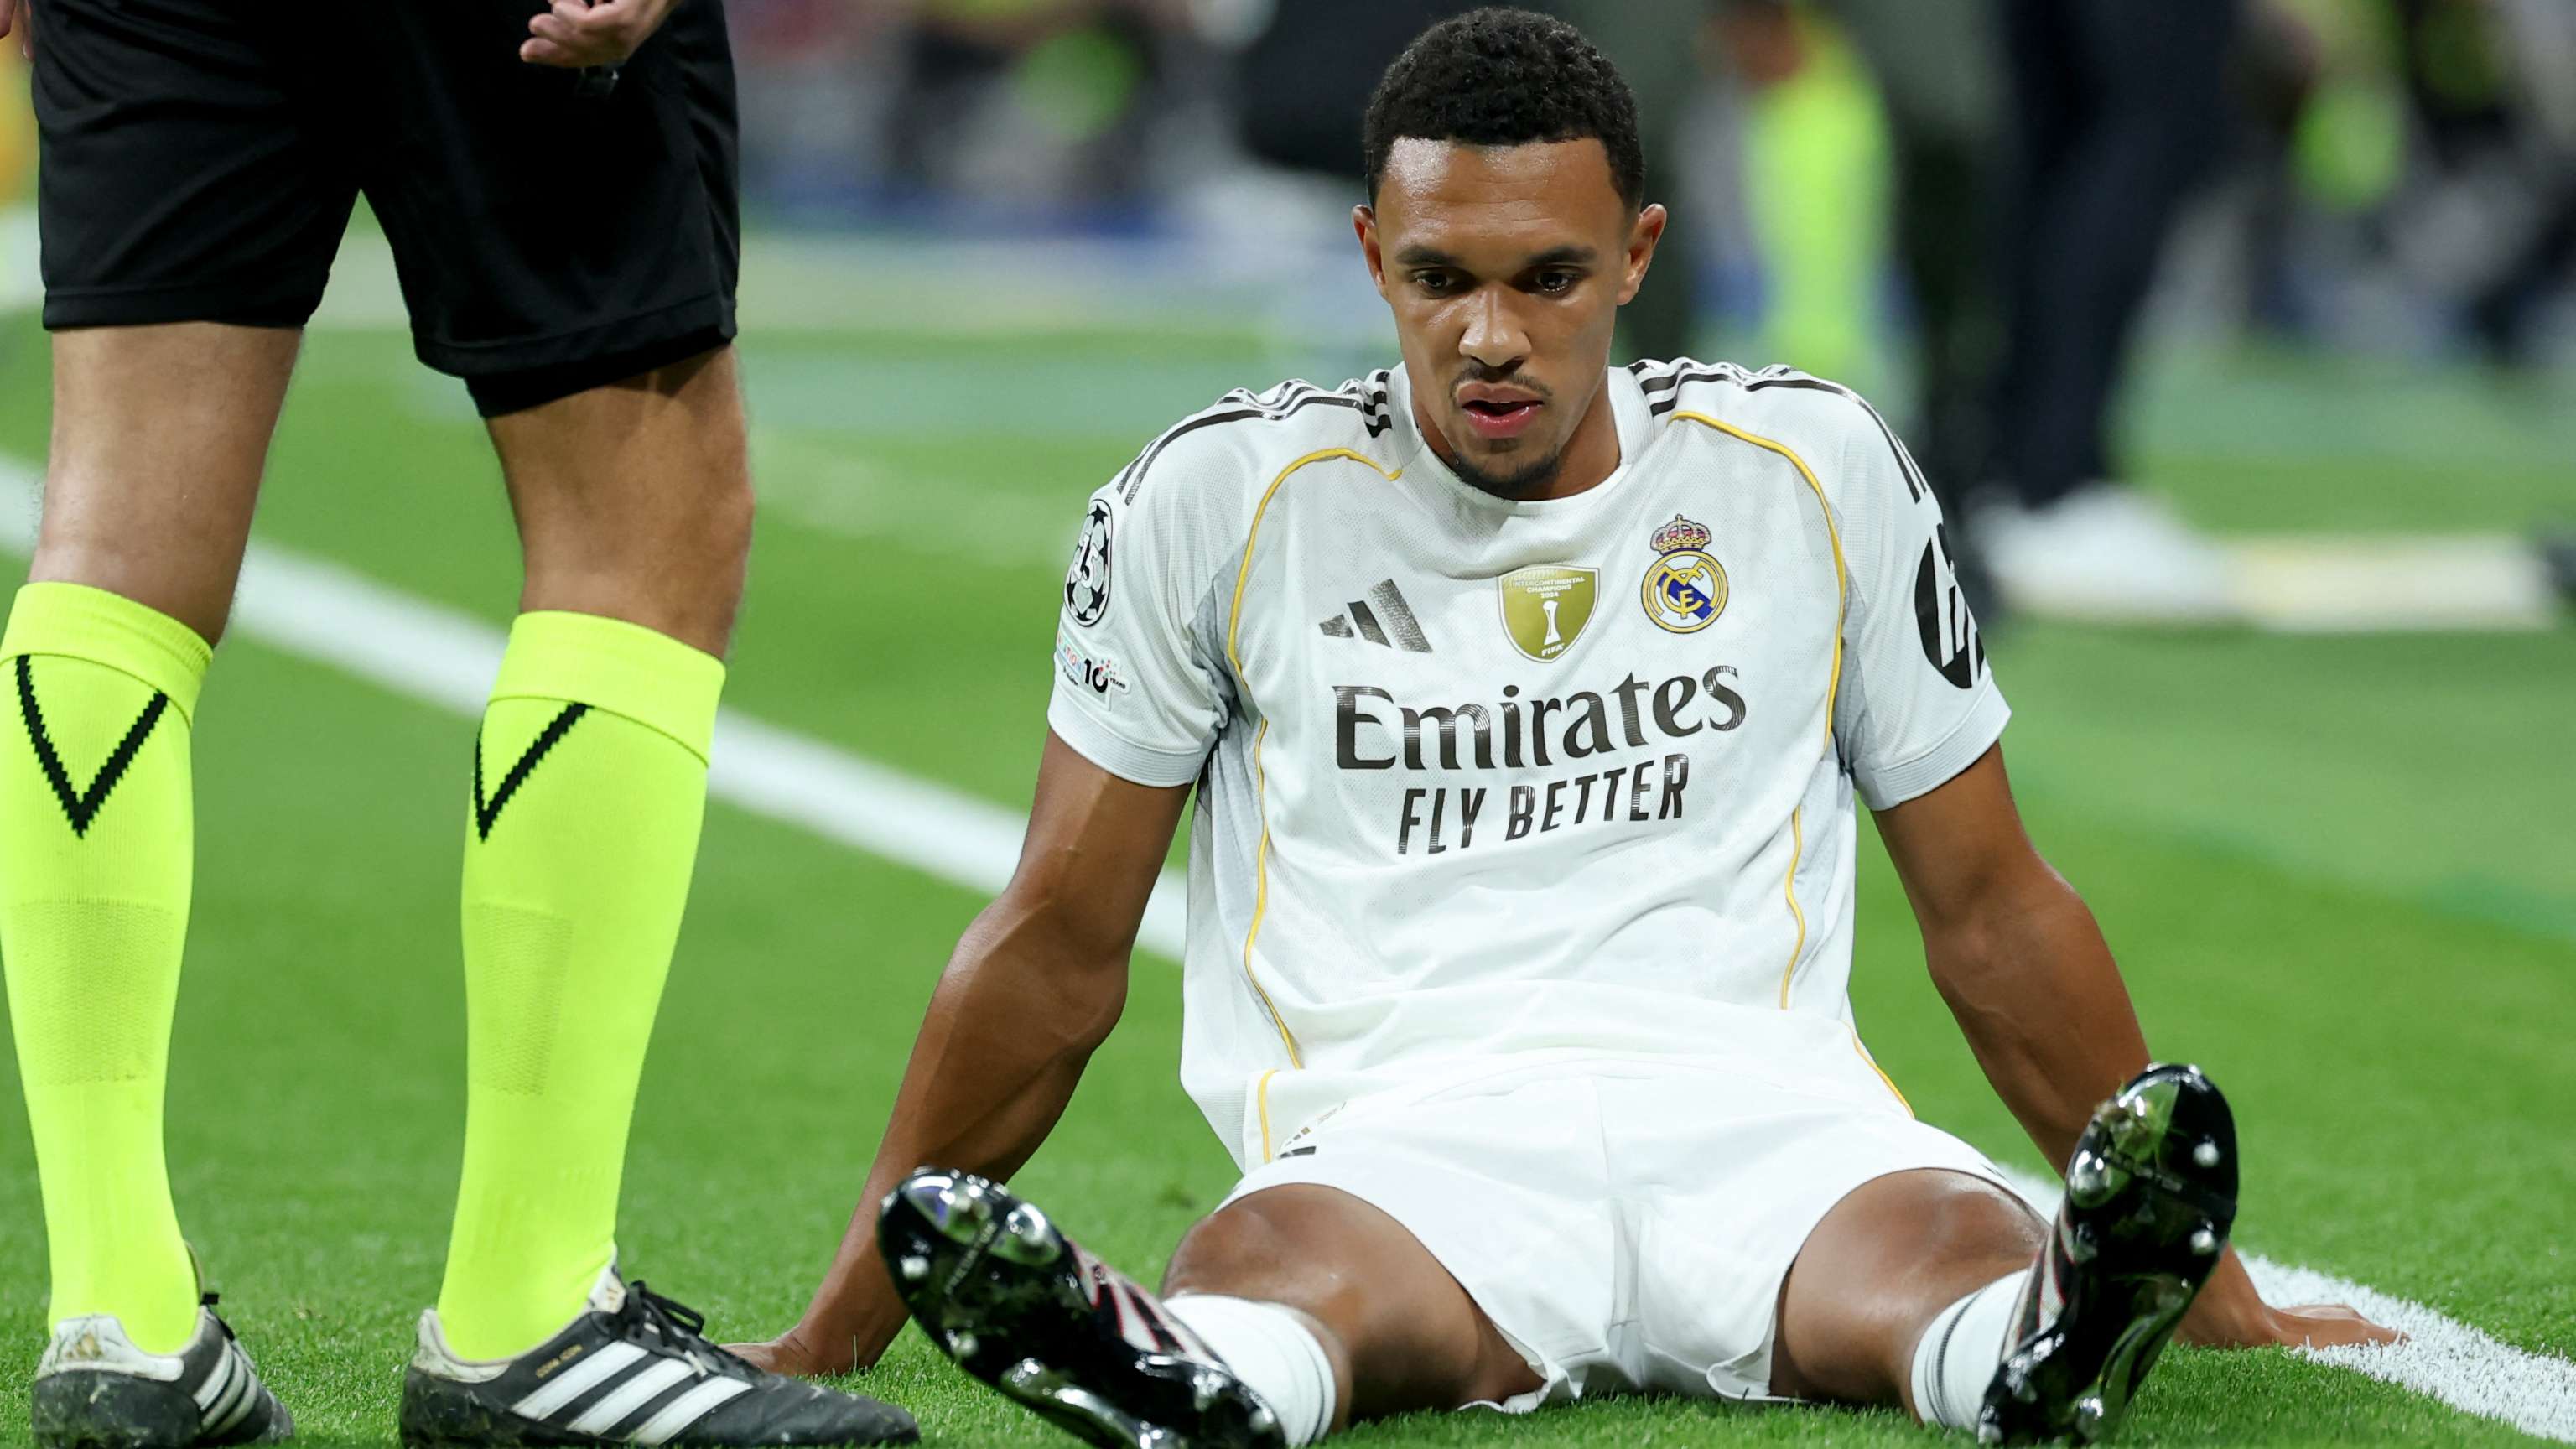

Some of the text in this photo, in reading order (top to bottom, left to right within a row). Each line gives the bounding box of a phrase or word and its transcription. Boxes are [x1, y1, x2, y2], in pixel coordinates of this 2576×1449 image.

[1332, 665, 1747, 771] Emirates
[1398, 753, 1690, 854] FLY BETTER
